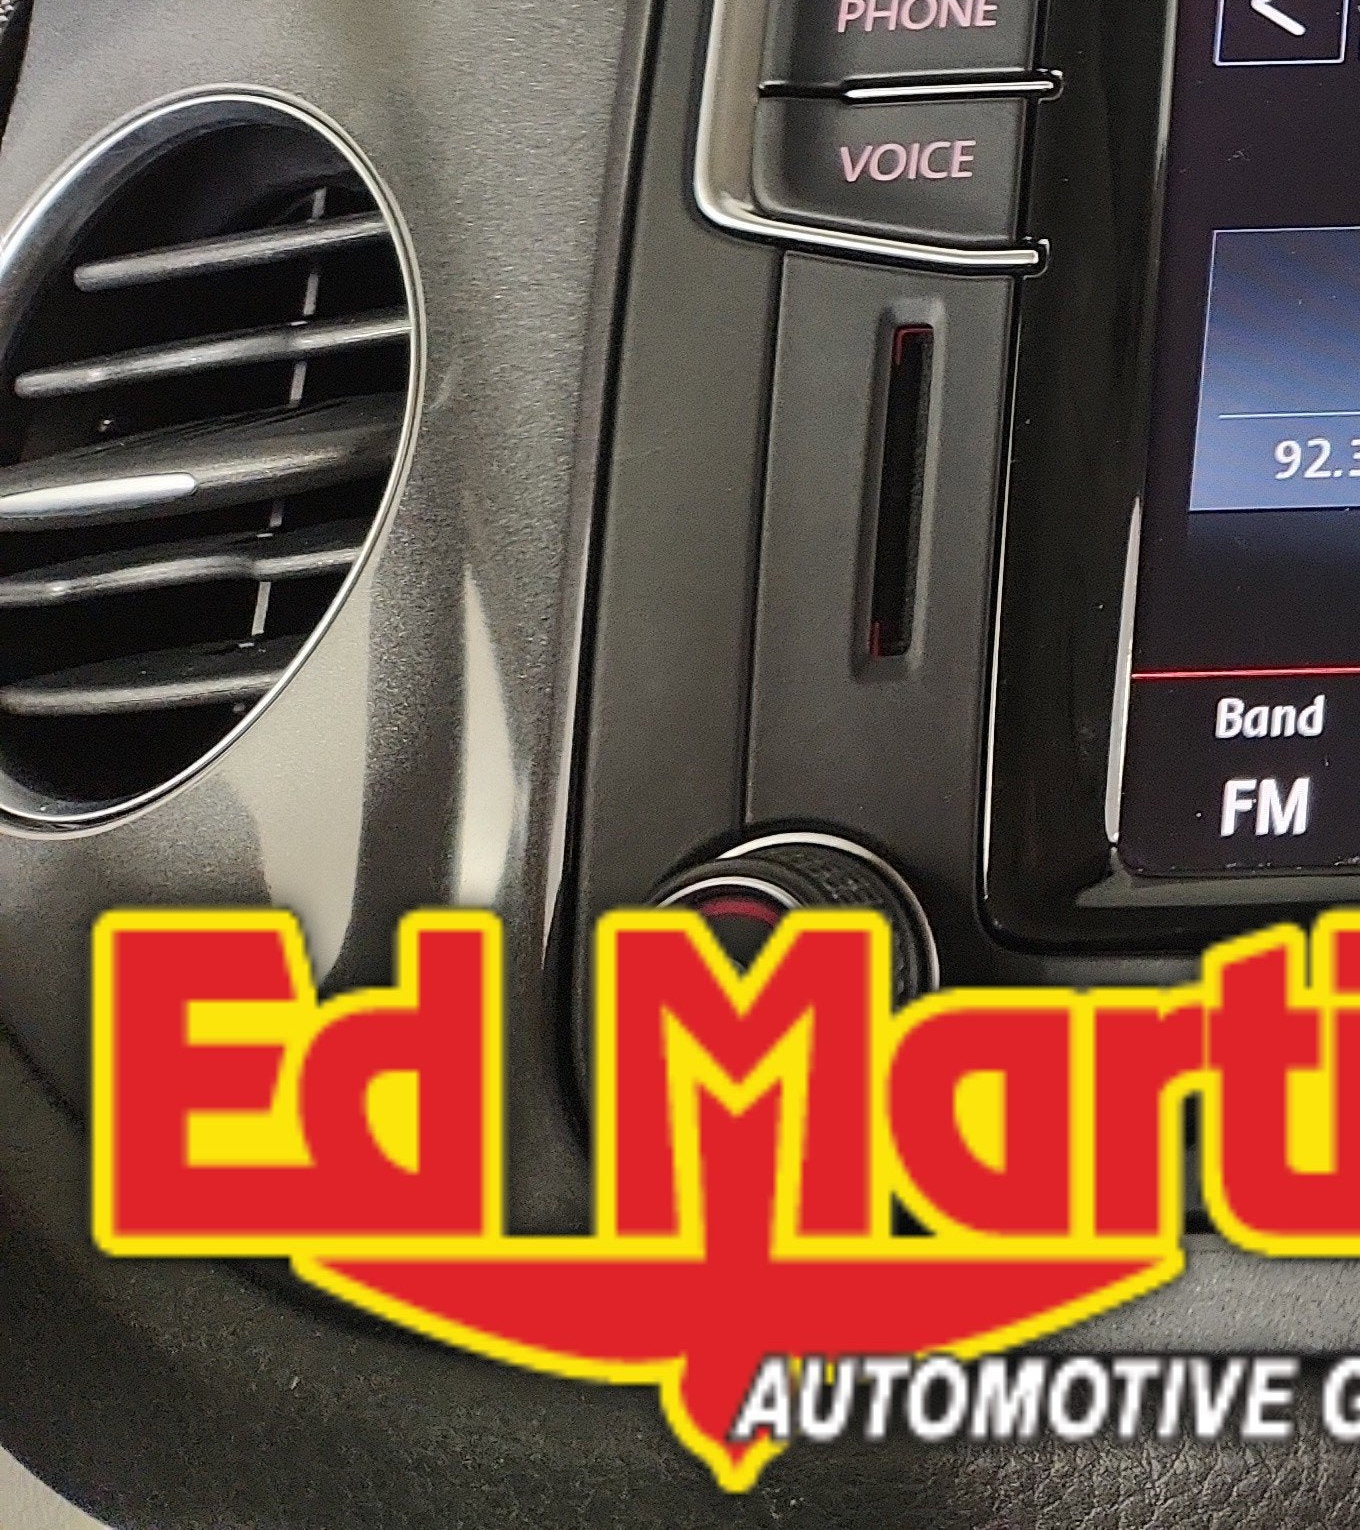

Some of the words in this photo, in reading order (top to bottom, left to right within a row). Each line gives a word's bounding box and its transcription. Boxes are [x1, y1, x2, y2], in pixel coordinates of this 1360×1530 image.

[839, 139, 977, 183] VOICE
[1215, 694, 1325, 739] Band
[1220, 776, 1311, 837] FM
